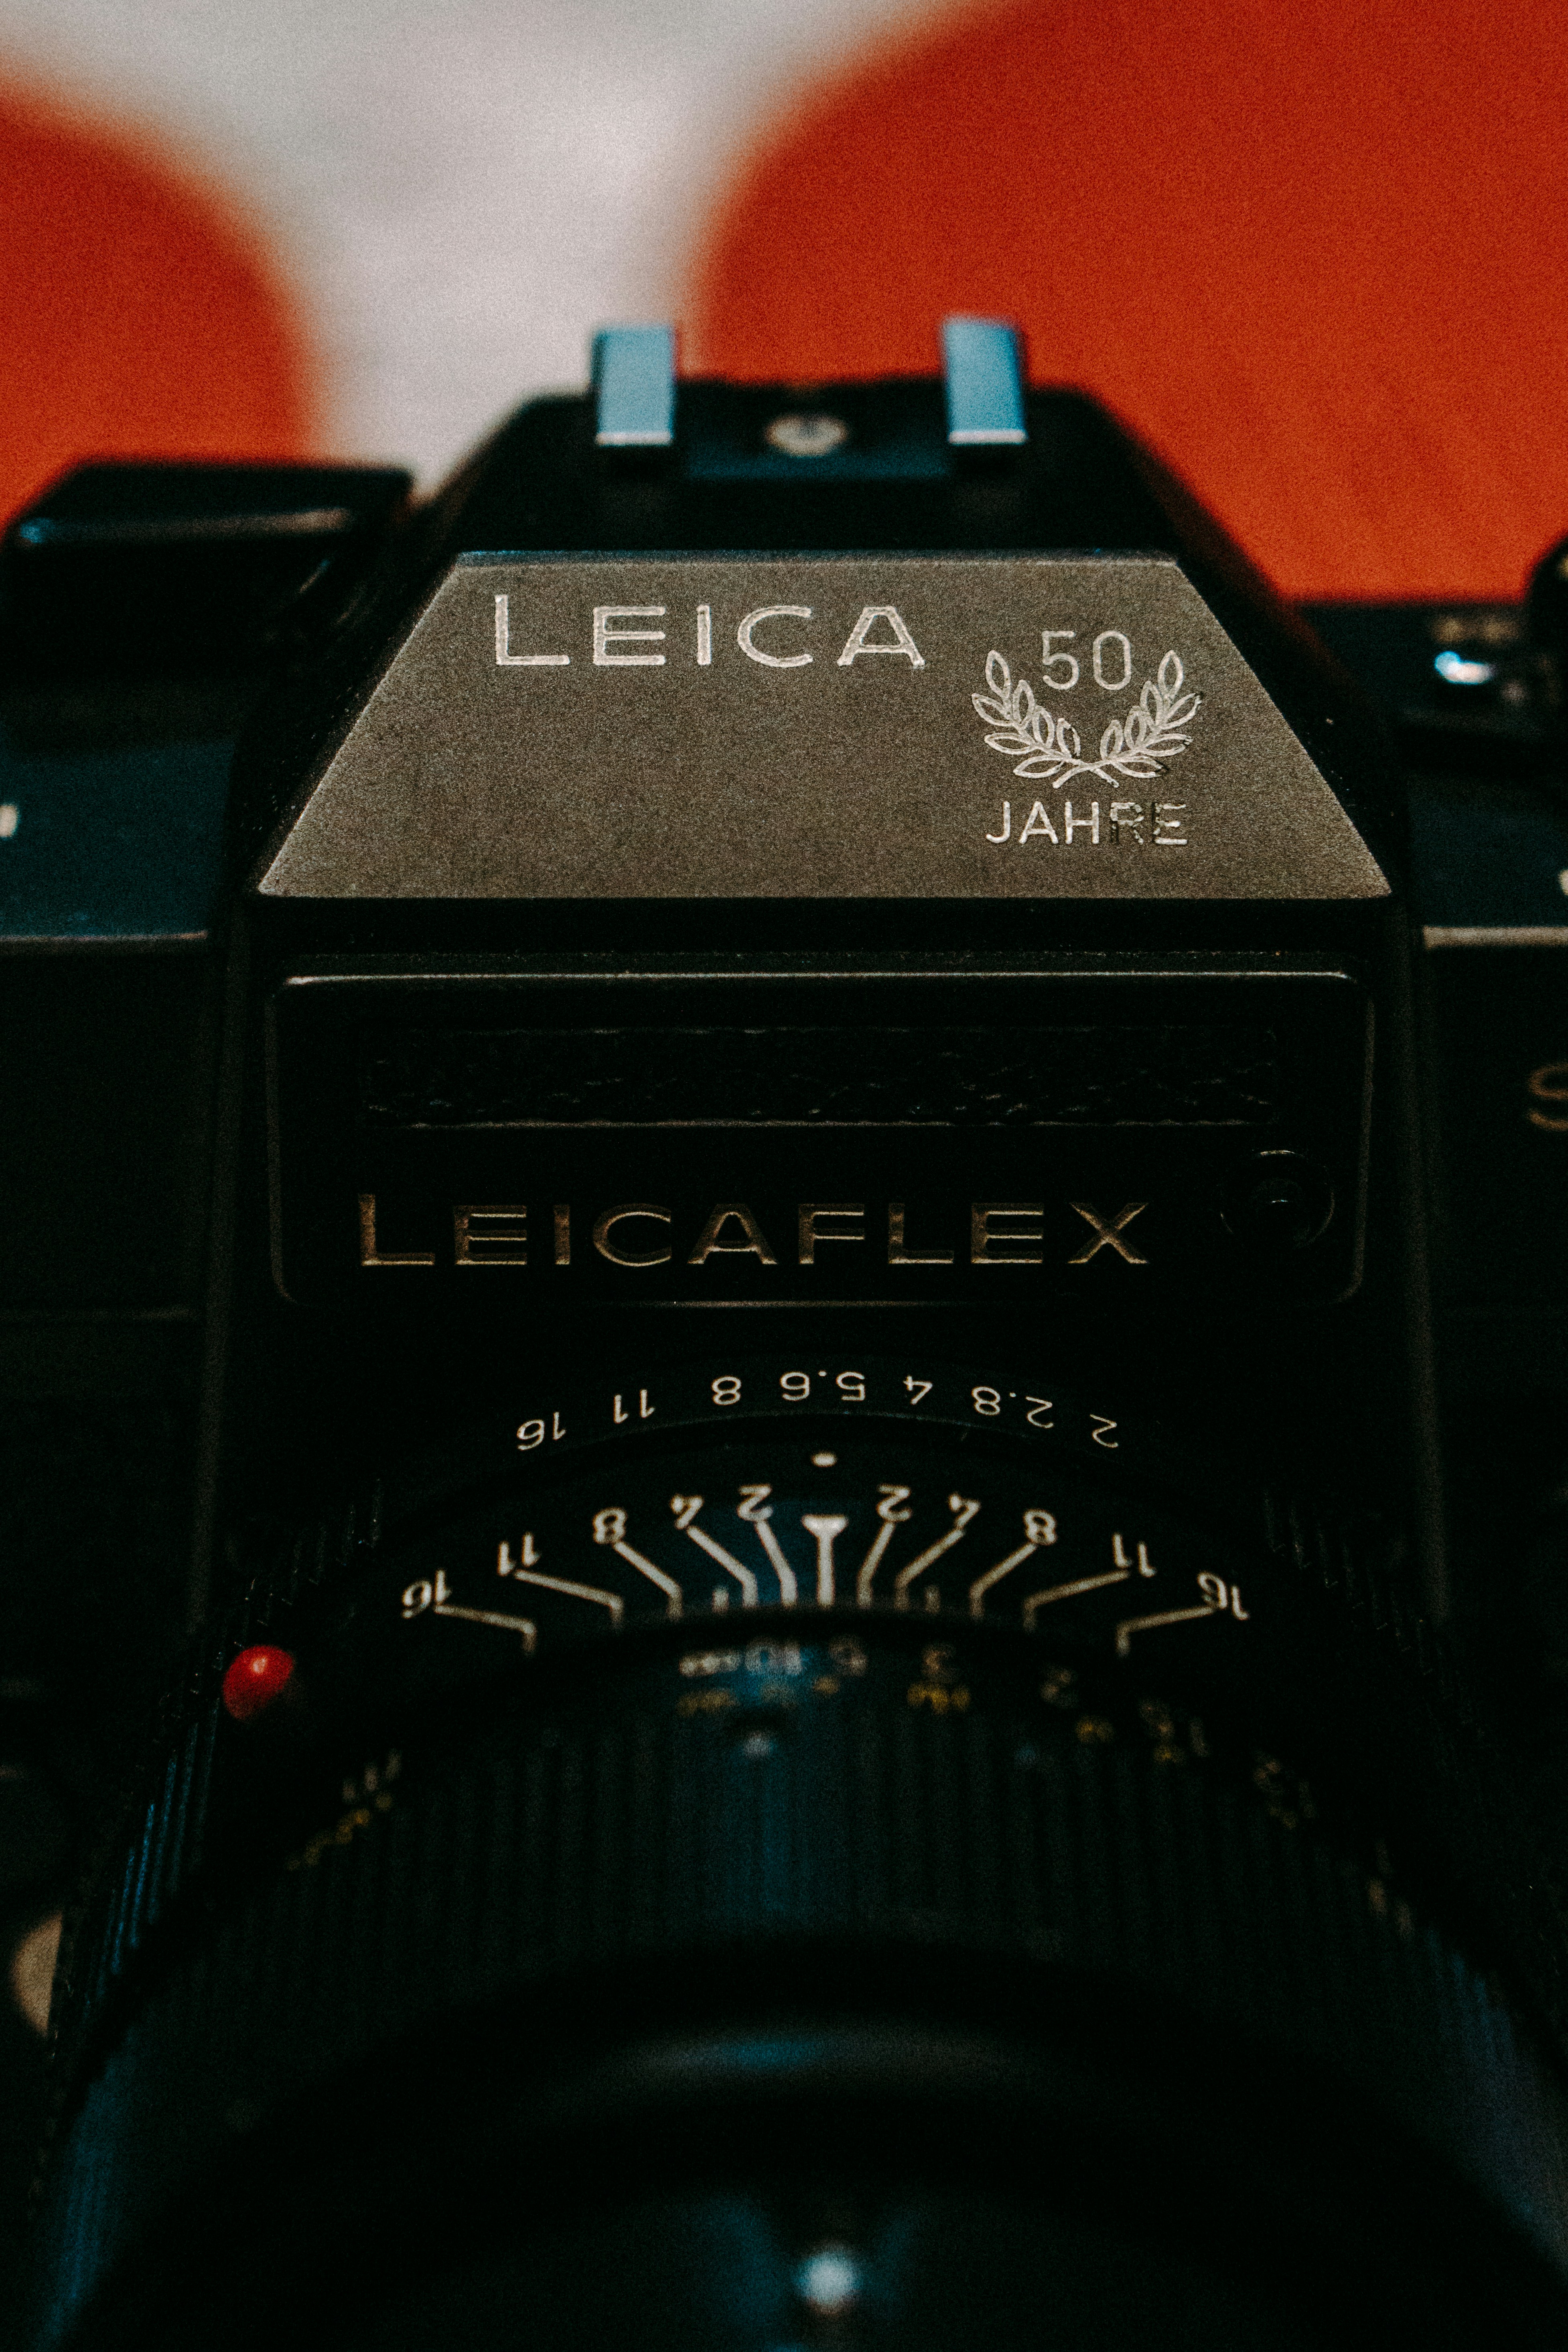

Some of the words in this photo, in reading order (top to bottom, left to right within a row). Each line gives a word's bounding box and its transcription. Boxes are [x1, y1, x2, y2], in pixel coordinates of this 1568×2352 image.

[493, 593, 927, 669] LEICA
[1040, 629, 1133, 692] 50
[985, 799, 1188, 846] JAHRE
[359, 1193, 1150, 1268] LEICAFLEX
[710, 1375, 742, 1406] 8
[778, 1370, 866, 1402] 5.6
[903, 1374, 934, 1406] 4
[613, 1388, 655, 1425] 11
[970, 1385, 1054, 1429] 2.8
[516, 1411, 566, 1452] 16
[1089, 1413, 1119, 1448] 2
[670, 1493, 704, 1530] 4
[736, 1484, 773, 1521] 2
[876, 1484, 912, 1523] 2
[948, 1492, 980, 1529] 4
[592, 1507, 627, 1544] 8
[1023, 1508, 1058, 1546] 8
[497, 1532, 541, 1577] 11
[1112, 1533, 1156, 1578] 11
[402, 1569, 451, 1619] 16
[1197, 1571, 1249, 1621] 16
